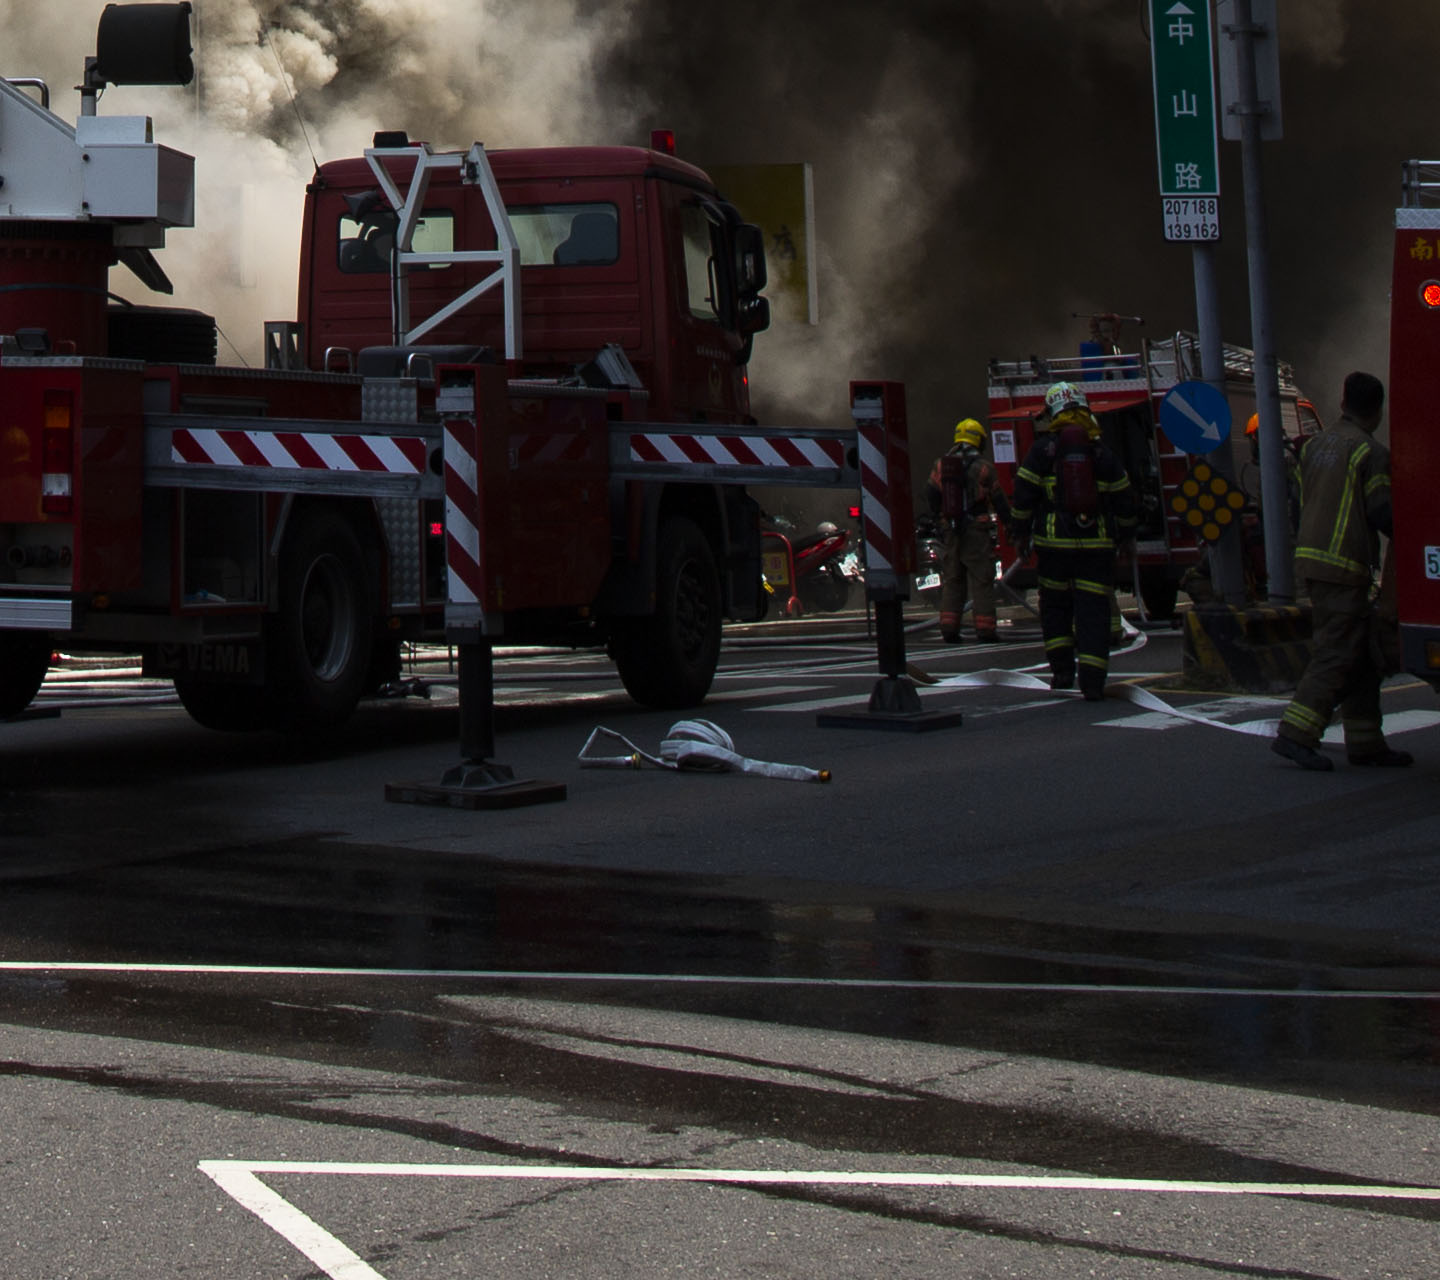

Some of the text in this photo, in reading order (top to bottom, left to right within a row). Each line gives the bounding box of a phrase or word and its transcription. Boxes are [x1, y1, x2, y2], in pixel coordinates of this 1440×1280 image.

[1167, 16, 1203, 190] 中山路
[1165, 199, 1216, 215] 207 188
[1168, 223, 1218, 239] 139 162
[186, 643, 251, 674] VEMA
